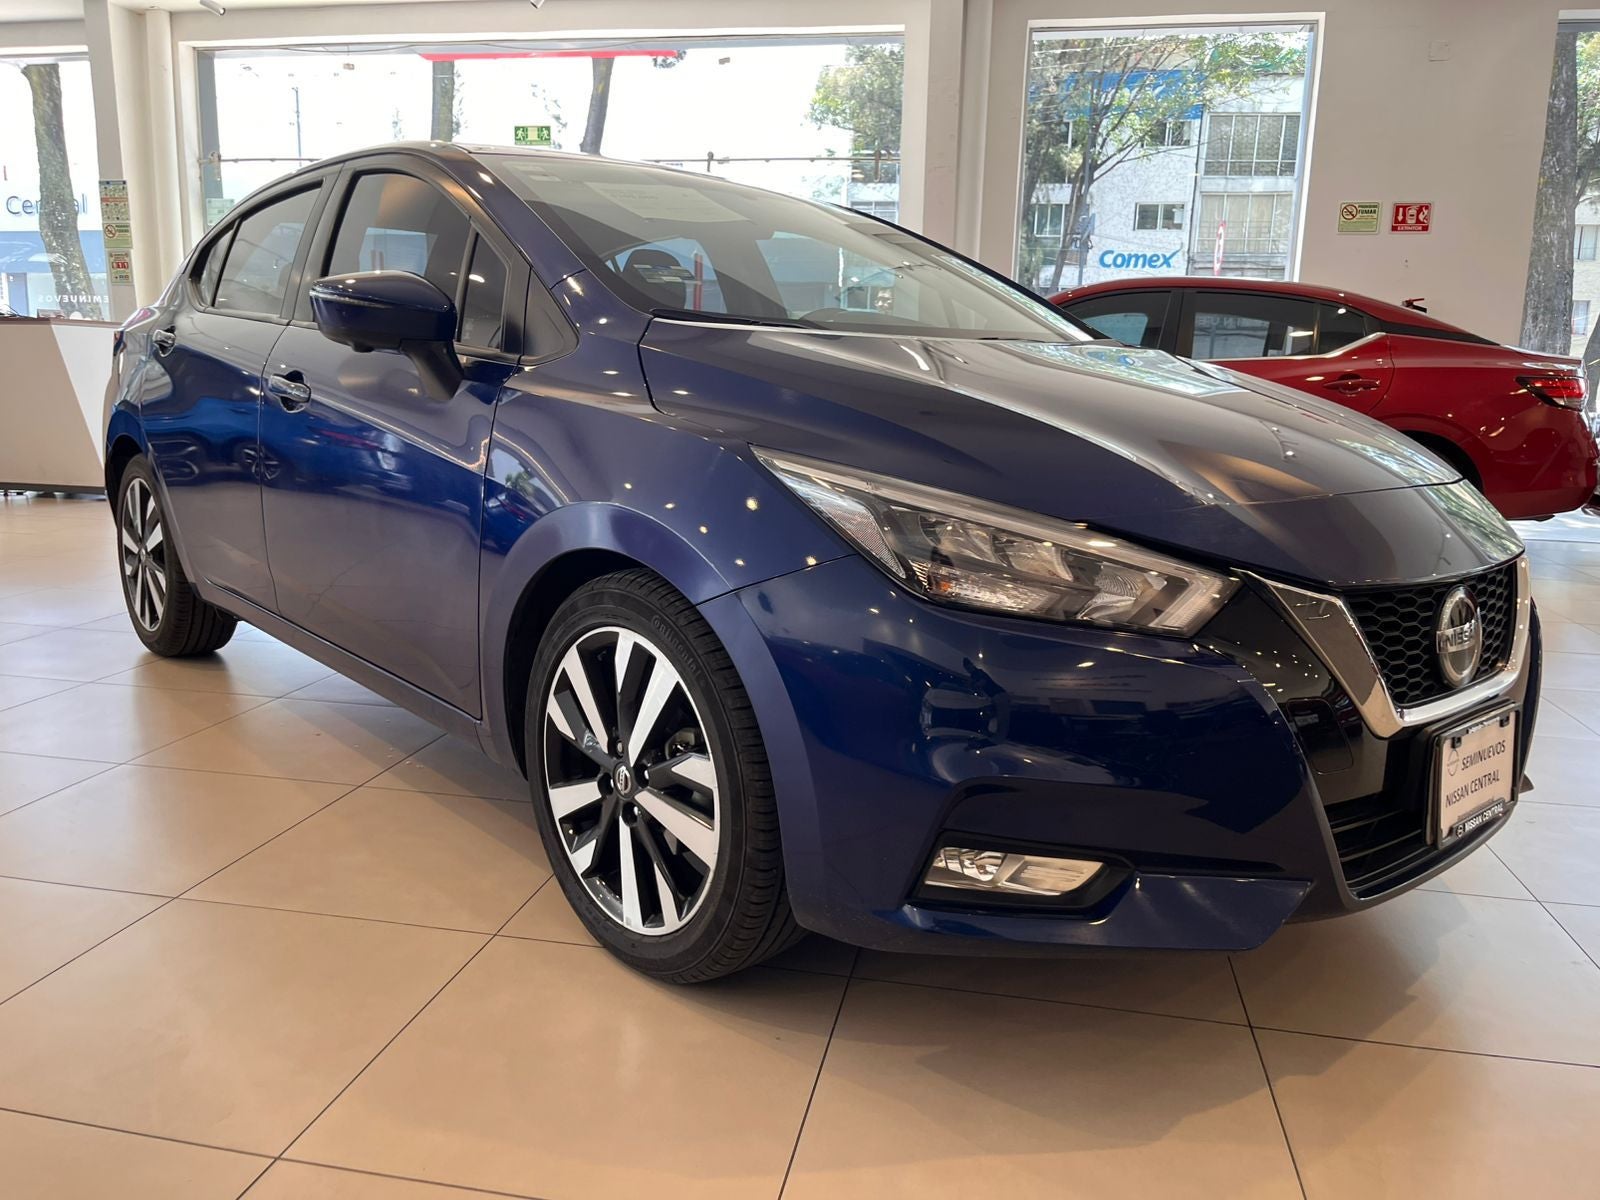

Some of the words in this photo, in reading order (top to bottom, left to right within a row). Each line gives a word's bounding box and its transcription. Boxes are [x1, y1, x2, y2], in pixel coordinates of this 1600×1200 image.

[1099, 243, 1183, 269] Comex
[1461, 740, 1506, 771] SEMINUEVOS
[1445, 785, 1470, 808] NISSAN
[1470, 769, 1501, 795] CENTRAL
[1464, 815, 1482, 831] NISSAN
[1482, 803, 1505, 823] CENTRAL
